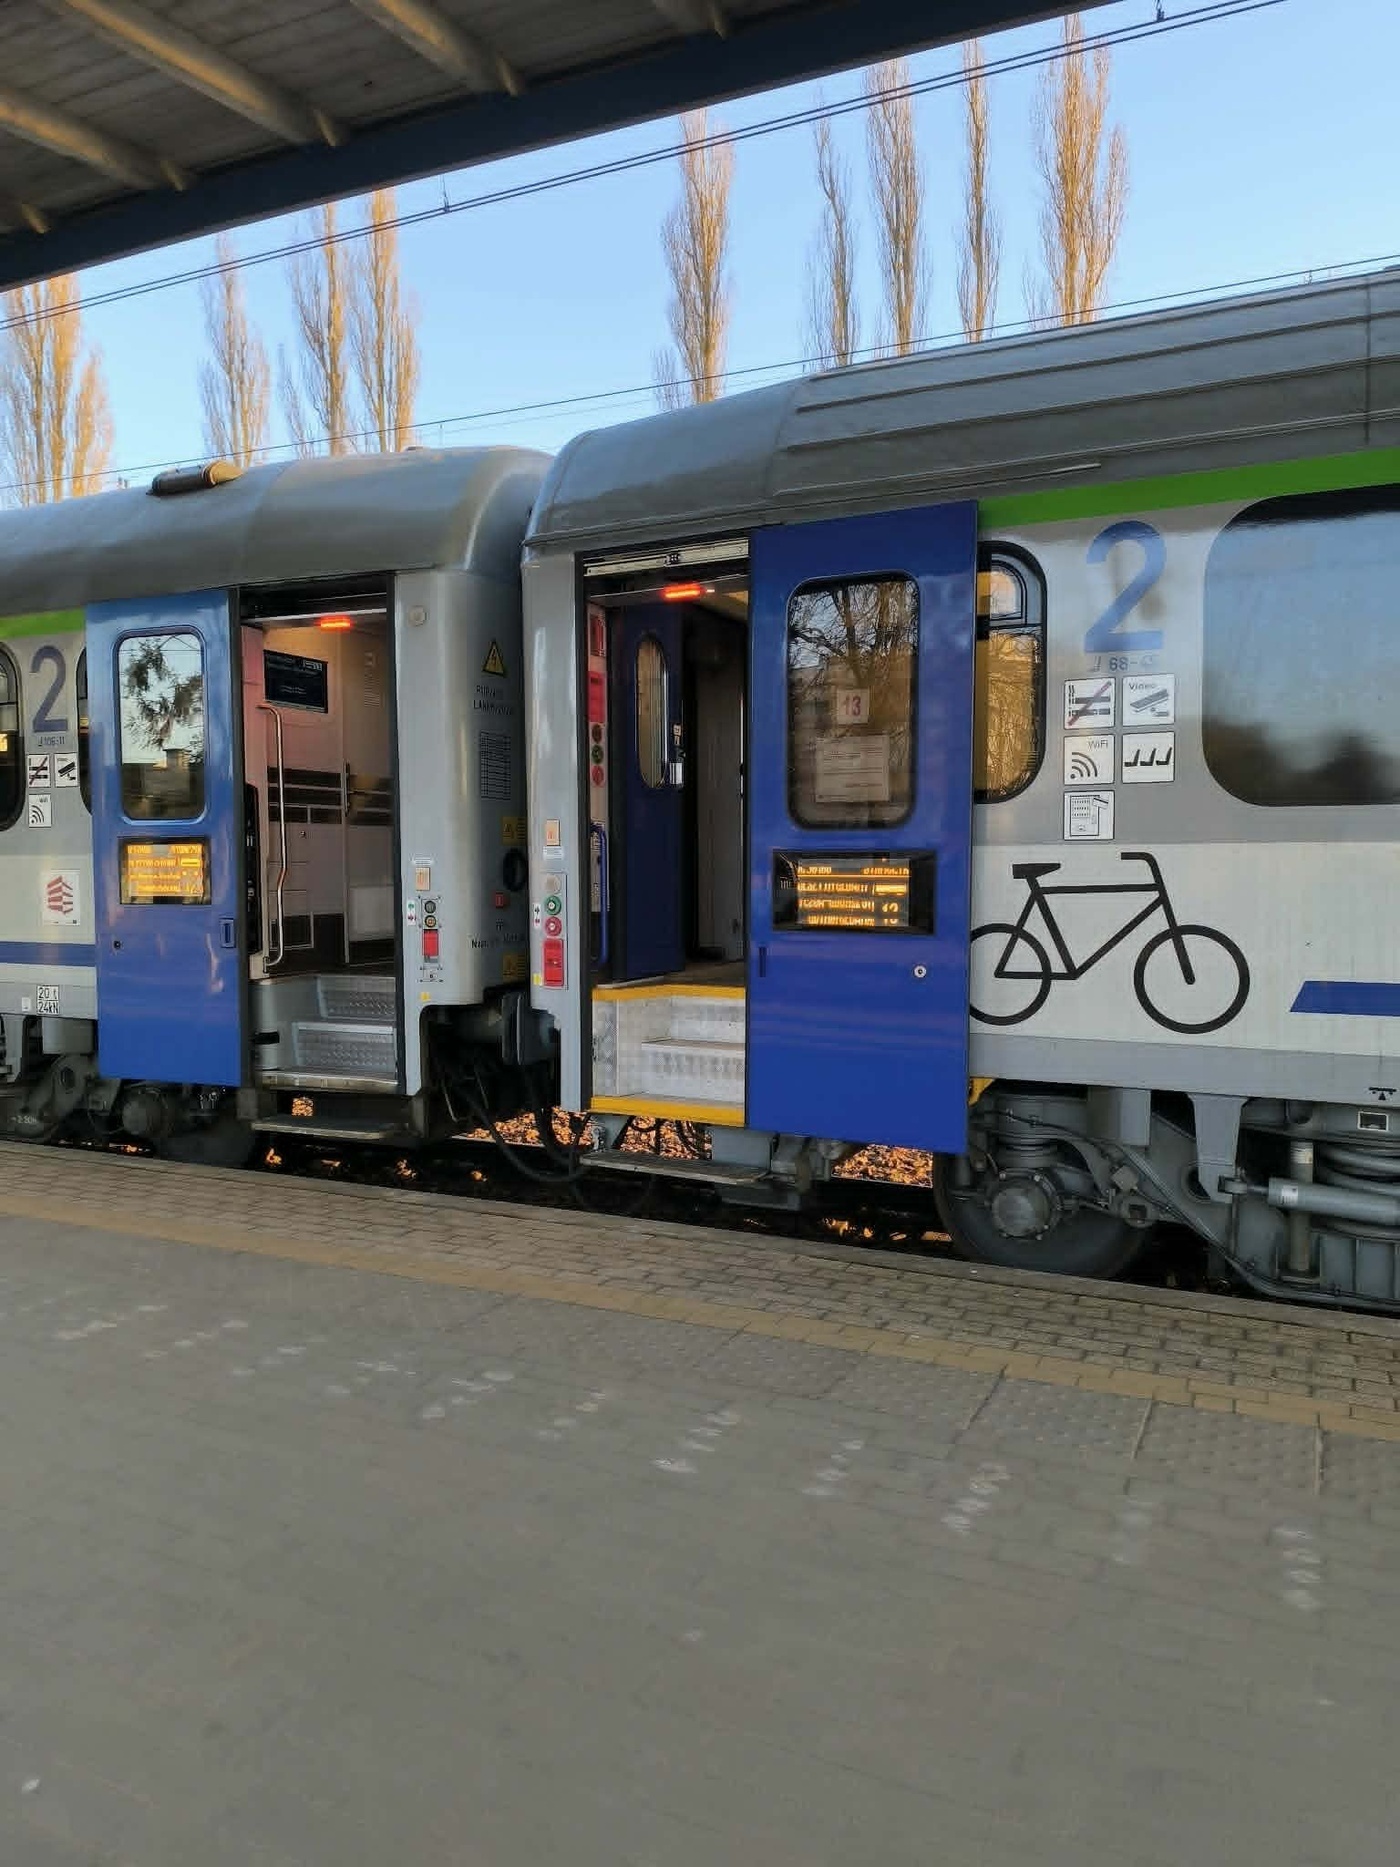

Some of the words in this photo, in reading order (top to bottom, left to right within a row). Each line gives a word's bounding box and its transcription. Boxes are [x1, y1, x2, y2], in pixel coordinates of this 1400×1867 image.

[1084, 520, 1167, 652] 2
[30, 645, 68, 733] 2
[38, 987, 50, 1000] 20
[38, 1001, 59, 1014] 24kN
